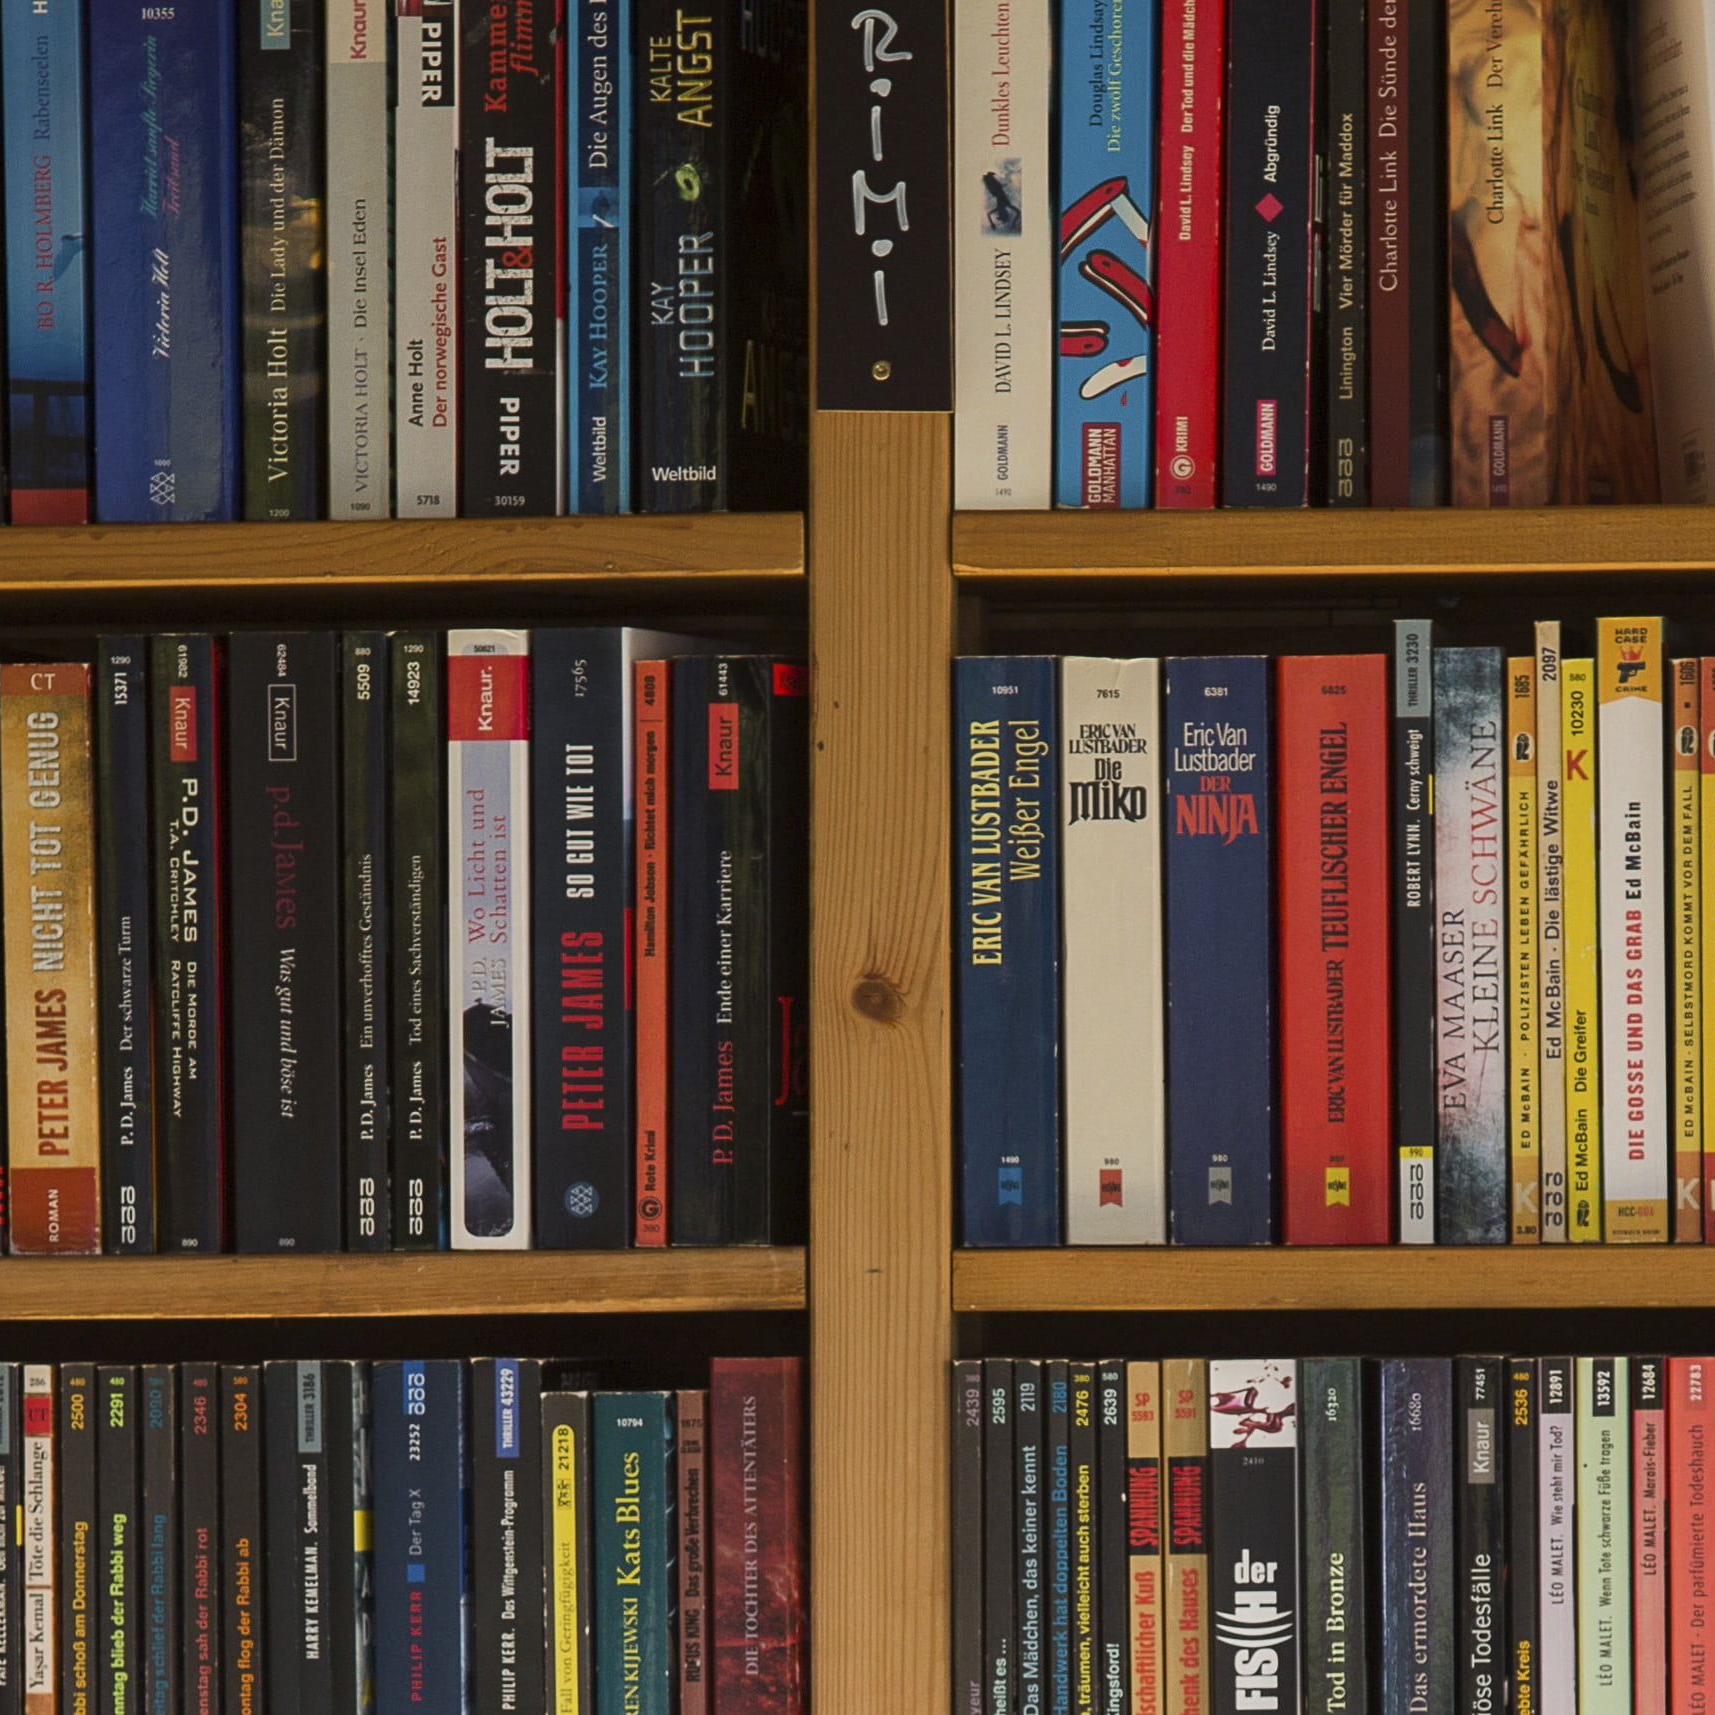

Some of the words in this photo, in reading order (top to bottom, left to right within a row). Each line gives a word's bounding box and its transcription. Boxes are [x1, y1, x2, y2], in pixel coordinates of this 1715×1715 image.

[650, 34, 672, 104] KALTE
[677, 10, 714, 127] ANGST
[651, 281, 673, 326] KAY
[678, 233, 714, 377] HOOPER
[497, 397, 518, 475] PIPER
[651, 466, 715, 482] Weltbild
[1088, 428, 1104, 504] GOLDMANN
[1102, 428, 1118, 506] MANHATTAN
[493, 495, 525, 506] 30159
[478, 666, 493, 731] Knaur.
[992, 686, 1017, 694] 10951
[1097, 689, 1119, 698] 7615
[1204, 687, 1228, 696] 6381
[1175, 748, 1256, 772] Lustbader
[1184, 722, 1211, 746] Eric
[1216, 722, 1246, 746] Van
[1095, 759, 1121, 781] Die
[1200, 776, 1231, 793] DER
[1070, 782, 1147, 824] Miko
[1176, 793, 1258, 845] NINJA
[36, 989, 67, 1069] JAMES
[39, 1077, 68, 1157] PETER
[1473, 1422, 1489, 1474] Knaur
[616, 1451, 640, 1524] Blues
[618, 1529, 641, 1587] Kats
[1325, 1551, 1345, 1630] Bronze
[1327, 1637, 1345, 1661] in
[1327, 1669, 1348, 1714] Tod
